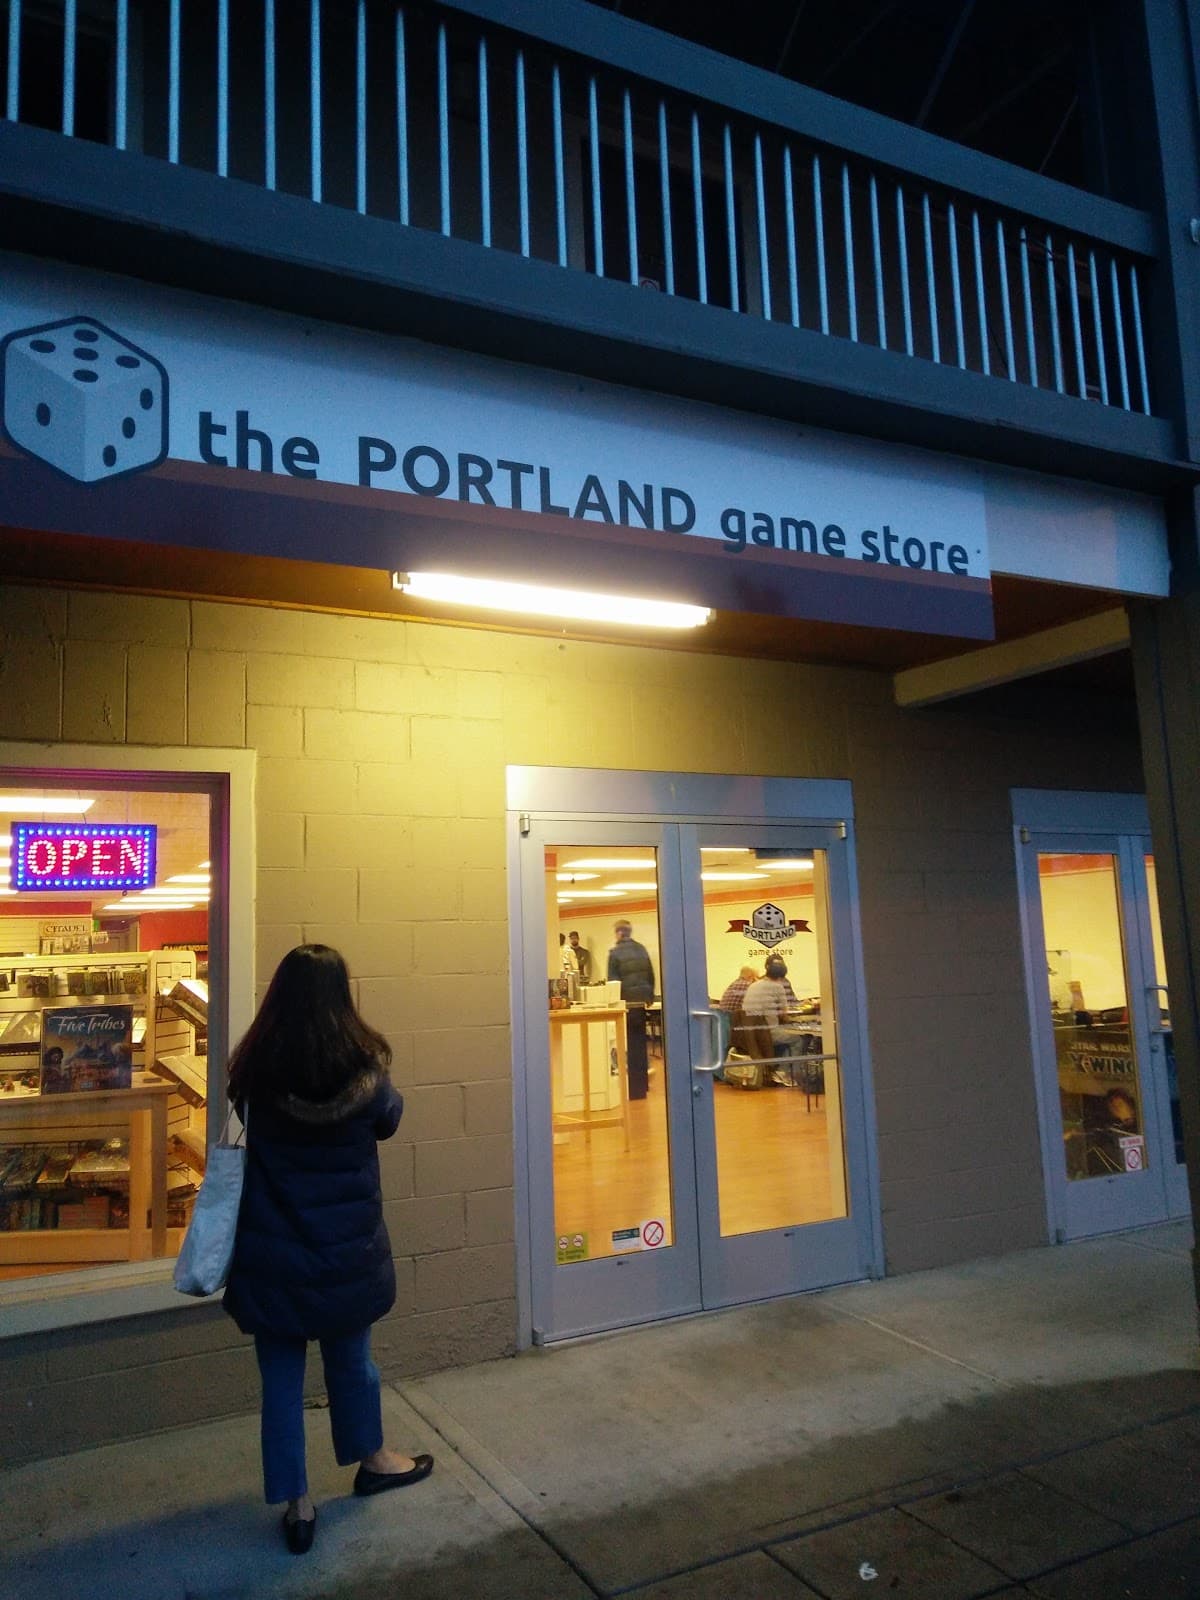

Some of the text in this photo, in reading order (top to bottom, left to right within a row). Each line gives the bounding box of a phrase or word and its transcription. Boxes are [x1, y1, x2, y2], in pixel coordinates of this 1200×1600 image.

[199, 410, 969, 576] the PORTLAND game store
[27, 839, 142, 876] OPEN
[745, 927, 794, 940] PORTLAND
[748, 948, 793, 957] game store
[48, 1014, 125, 1036] Five Tribes
